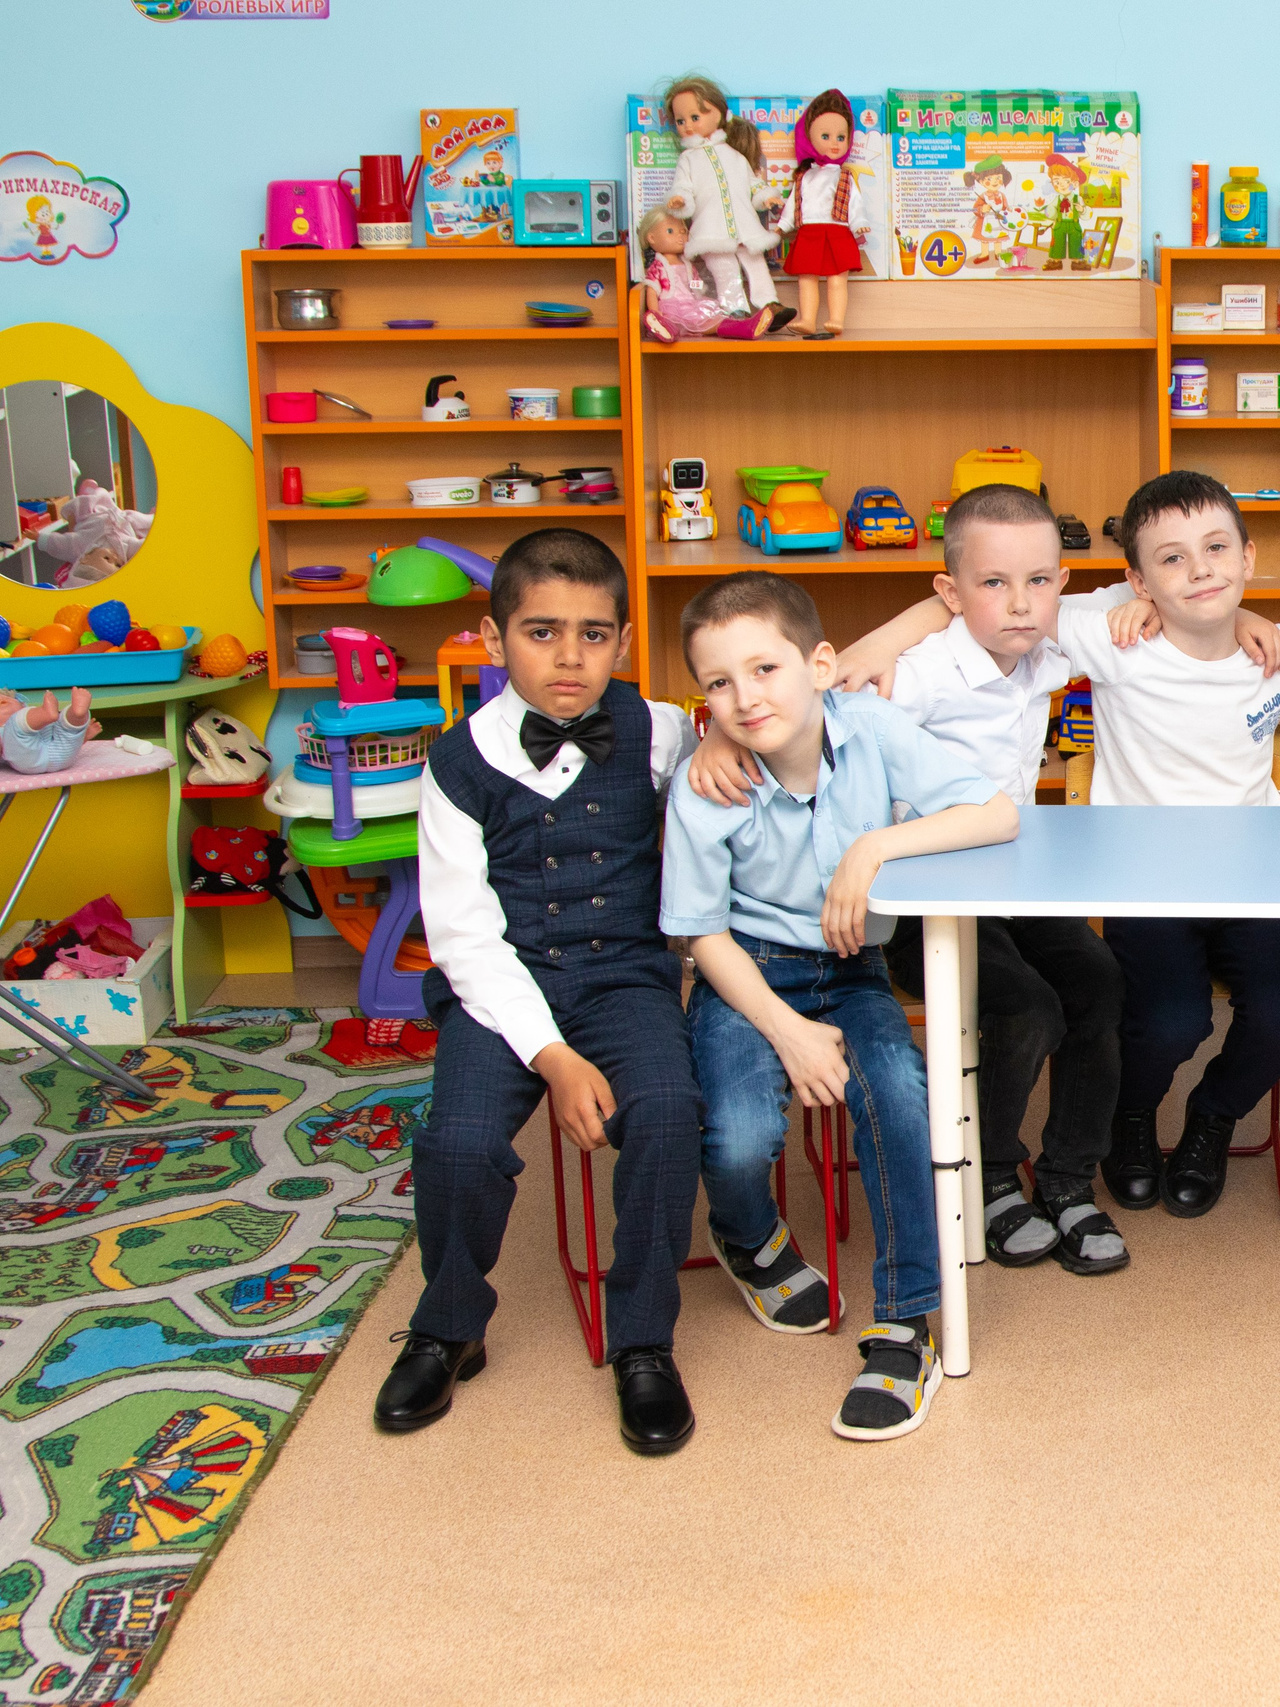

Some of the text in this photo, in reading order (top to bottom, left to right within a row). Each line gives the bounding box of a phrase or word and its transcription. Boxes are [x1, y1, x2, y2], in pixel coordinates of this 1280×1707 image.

[196, 0, 325, 14] РОЛЕВЫХ ИГР
[899, 136, 909, 153] 9
[1096, 147, 1119, 155] УМНЫЕ
[638, 152, 654, 165] 32
[896, 153, 913, 166] 32
[924, 238, 963, 268] 4+
